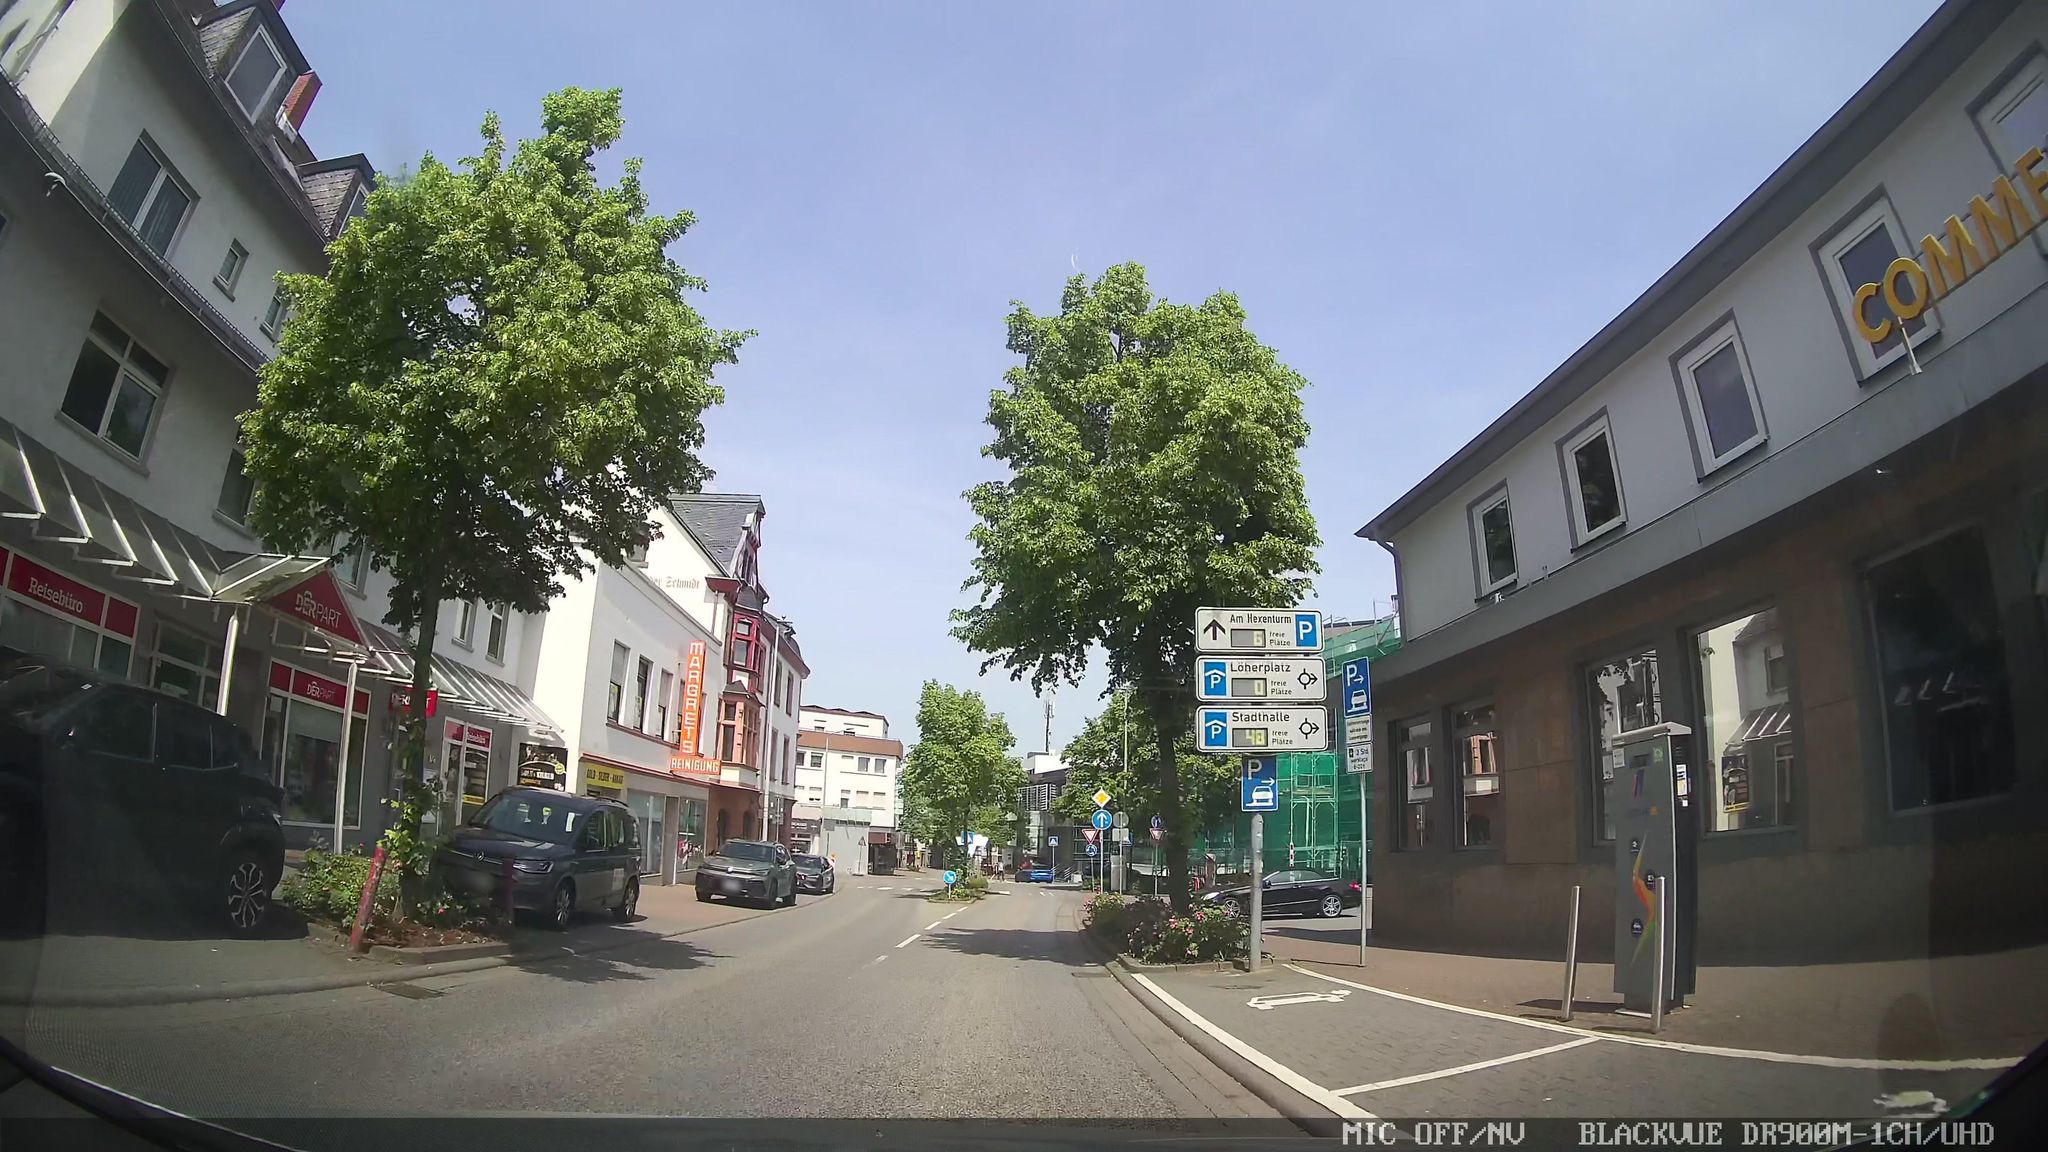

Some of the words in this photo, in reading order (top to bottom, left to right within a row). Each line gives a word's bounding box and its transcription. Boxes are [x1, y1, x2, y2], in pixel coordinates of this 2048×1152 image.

[29, 577, 84, 613] Reisebüro
[295, 593, 341, 628] DERPART
[1230, 614, 1243, 623] Am
[1247, 613, 1291, 624] Hexenturm
[1230, 662, 1291, 674] Löherplatz
[682, 641, 705, 754] MARGRETS
[1232, 712, 1290, 722] Stadthalle
[671, 758, 719, 773] REINIGUNG
